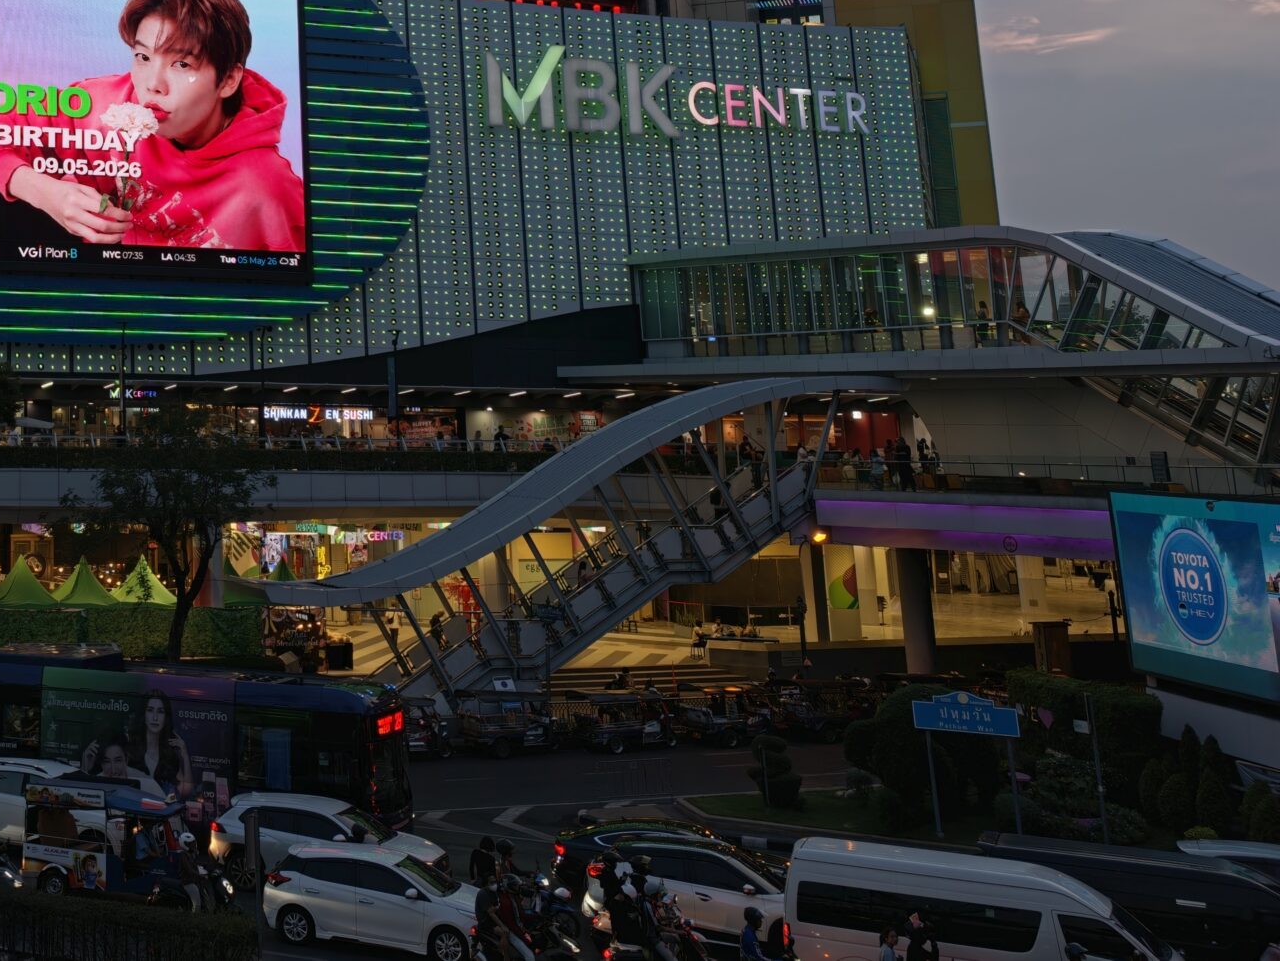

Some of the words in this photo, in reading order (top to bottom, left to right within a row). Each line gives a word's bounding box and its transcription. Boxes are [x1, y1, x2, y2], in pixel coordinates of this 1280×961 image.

[485, 45, 682, 138] MBK
[687, 81, 870, 134] CENTER
[33, 156, 142, 179] 09.05.2026
[102, 250, 121, 259] NYC
[122, 251, 144, 260] 07:35
[161, 253, 173, 261] LA
[174, 253, 196, 262] 04:35
[220, 255, 237, 264] Tue
[237, 256, 248, 264] 05
[249, 256, 266, 266] May
[267, 257, 277, 265] 26
[110, 387, 134, 399] MK
[343, 409, 373, 420] SUSHI
[368, 530, 404, 543] CENTER
[1171, 551, 1209, 568] TOYOTA
[1173, 567, 1212, 592] NO.1
[1176, 590, 1215, 606] TRUSTED
[1190, 608, 1215, 619] HEV
[939, 706, 992, 724] ปทุมวัน
